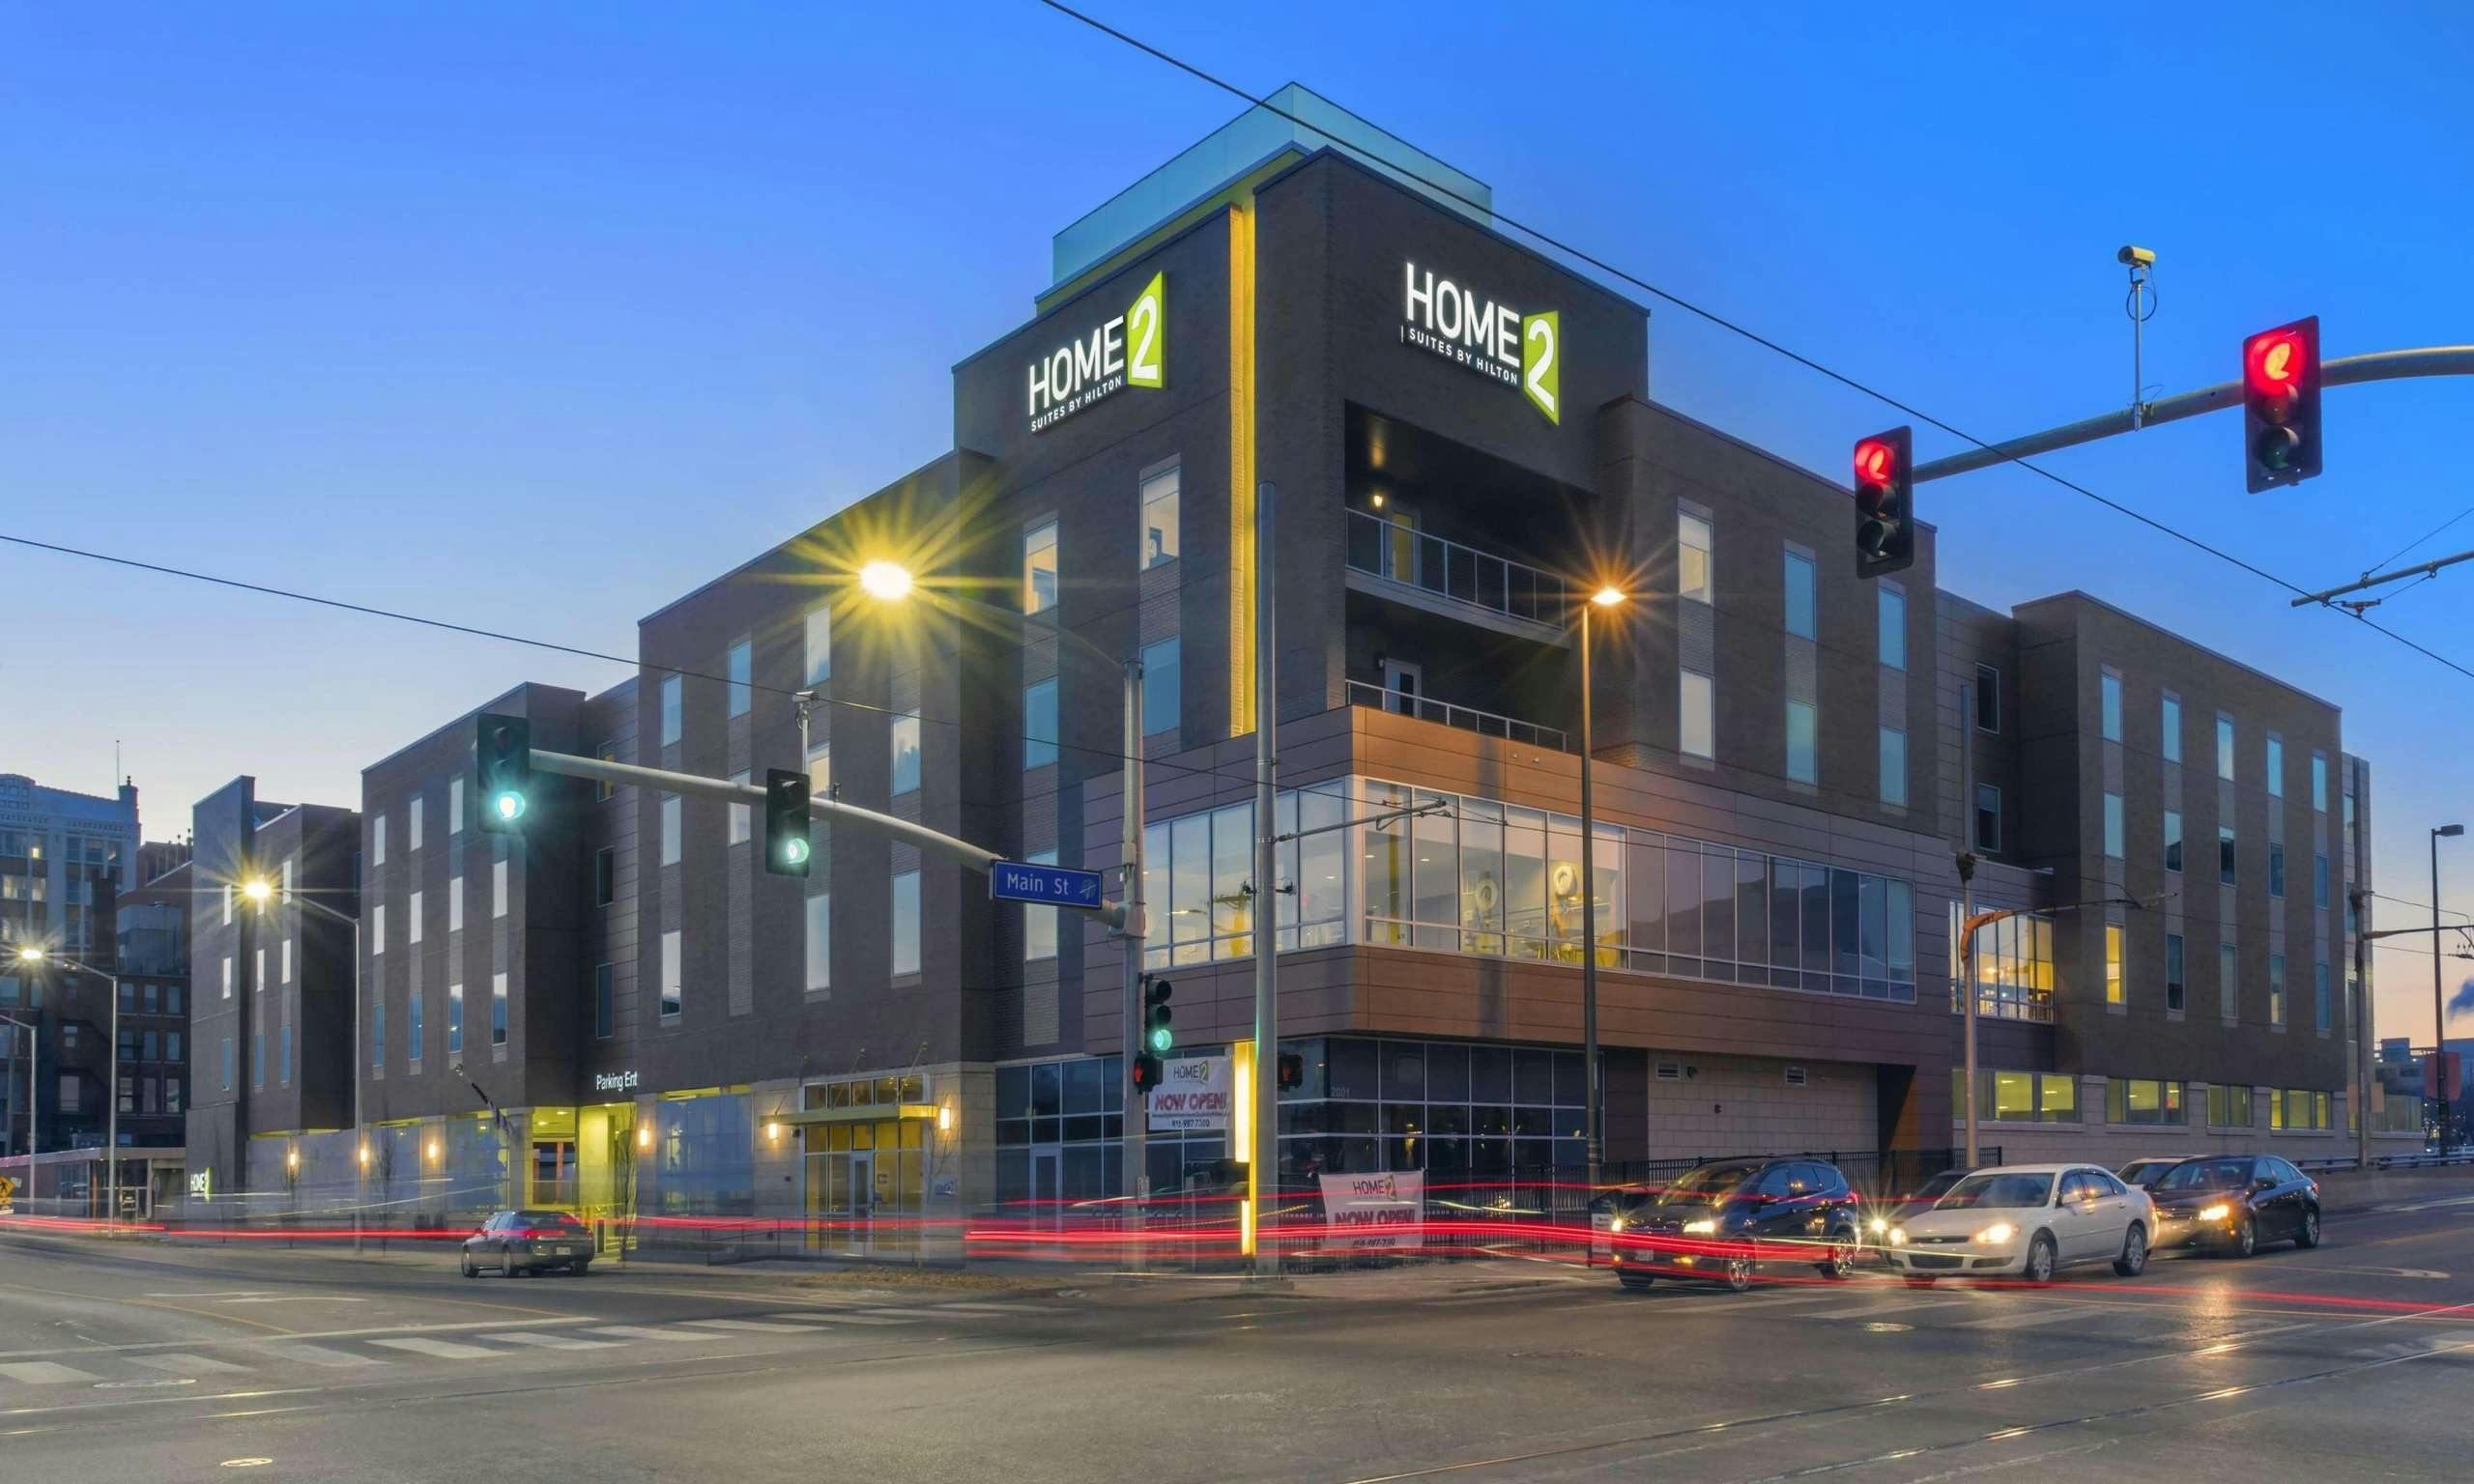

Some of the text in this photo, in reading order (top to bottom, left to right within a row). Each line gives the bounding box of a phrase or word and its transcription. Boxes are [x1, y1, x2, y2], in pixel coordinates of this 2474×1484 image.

[1407, 262, 1555, 413] HOME 2
[1029, 295, 1159, 416] HOME 2
[1409, 328, 1518, 385] SUITES BY HILTON
[1031, 375, 1122, 432] SUITES BY HILTON
[1007, 872, 1070, 896] Main St
[596, 1070, 638, 1092] Parking Ent
[1173, 1065, 1198, 1080] HOME
[1155, 1094, 1187, 1111] NOW
[1353, 1180, 1385, 1195] HOME
